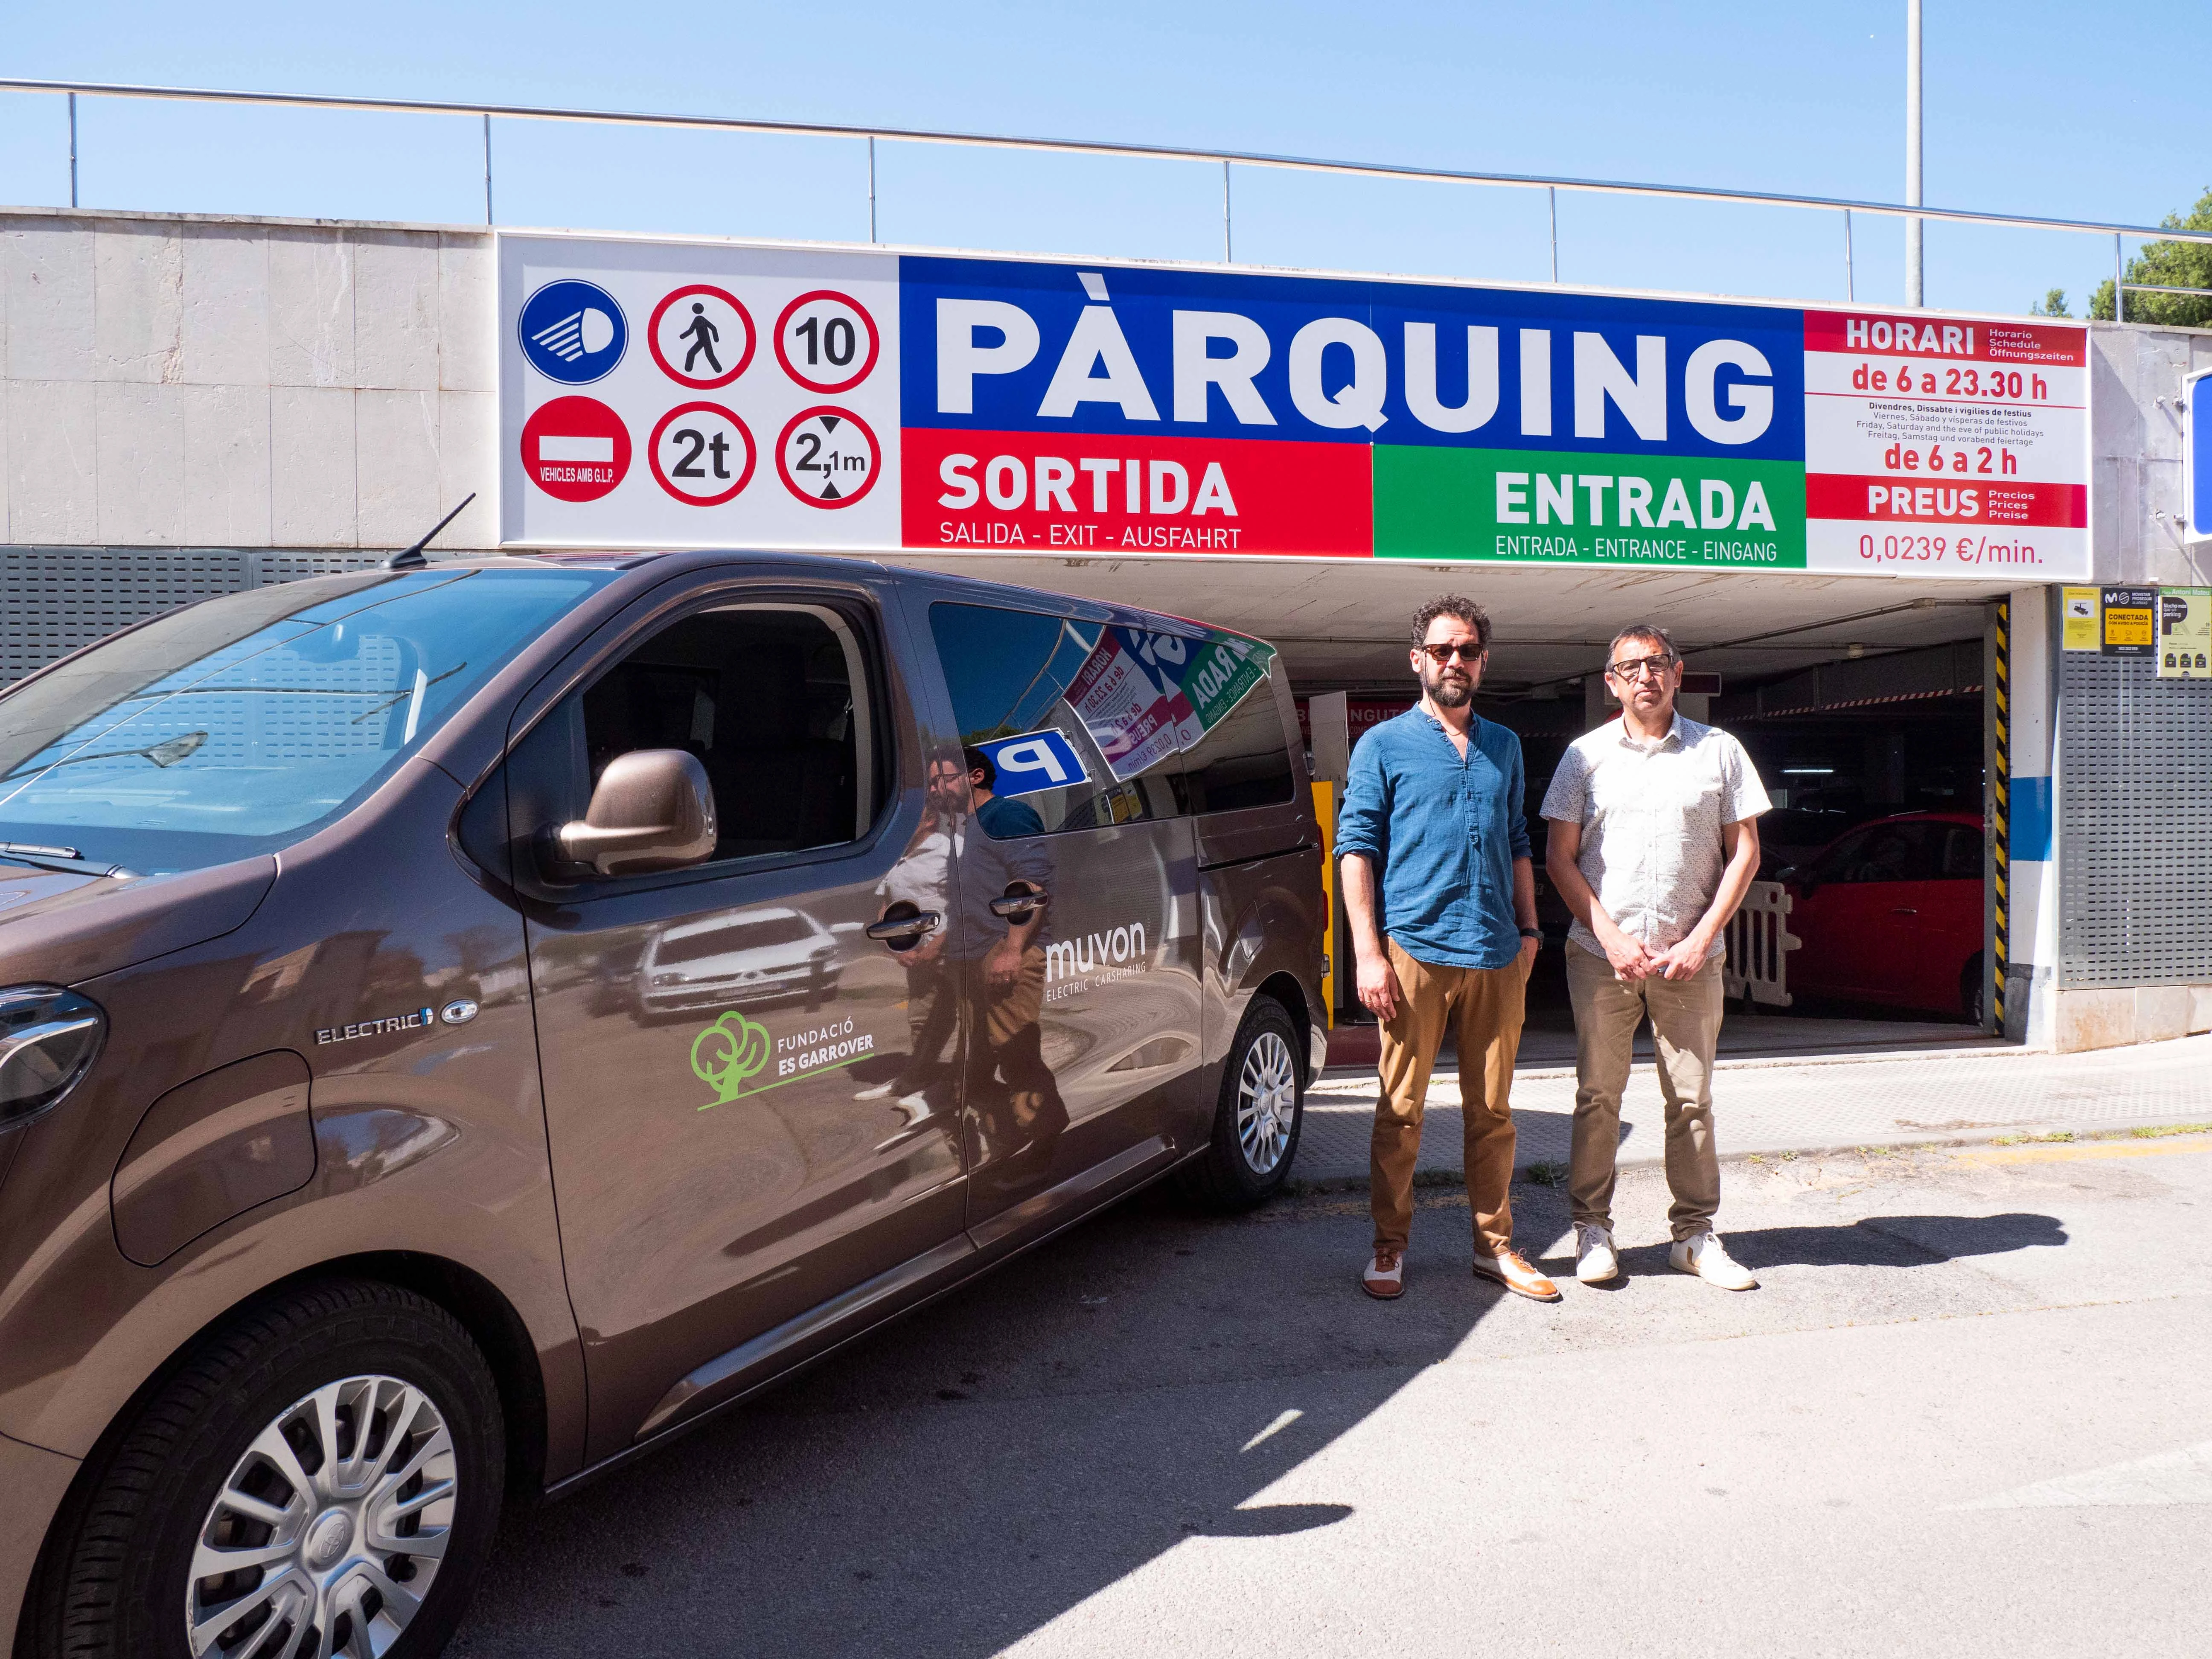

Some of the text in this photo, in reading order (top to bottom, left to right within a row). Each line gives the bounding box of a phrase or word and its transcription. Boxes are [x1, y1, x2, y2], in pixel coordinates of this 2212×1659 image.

[795, 317, 856, 366] 10
[1846, 319, 1974, 355] HORARI
[1989, 339, 2040, 349] Schedule
[1990, 329, 2032, 339] Horario
[937, 272, 1773, 444] PÀRQUING
[1989, 347, 2073, 361] Öffnungszeiten
[1853, 363, 2046, 400] de 6 a 23.30 h
[1869, 402, 1915, 412] Divendres,
[1917, 405, 1953, 413] Dissabte
[1874, 412, 1907, 421] Viernes,
[1910, 413, 1939, 422] Sábado
[1949, 416, 1982, 425] vísperas
[1857, 421, 1884, 430] Friday,
[1887, 422, 1924, 432] Saturday
[2011, 428, 2044, 438] holidays
[1868, 431, 1899, 440] Freitag,
[1902, 432, 1938, 442] Samstag
[1997, 437, 2033, 447] feiertage
[672, 428, 731, 479] 2t
[1885, 443, 2017, 474] de 6 a 2 h
[540, 467, 614, 483] VEHICLES AMB G.L.P.
[937, 453, 1238, 516] SORTIDA
[1496, 472, 1776, 531] ENTRADA
[1868, 485, 1979, 517] PREUS
[1988, 490, 2035, 499] Precios
[1988, 500, 2028, 509] Prices
[1988, 510, 2028, 519] Preise
[940, 522, 1025, 544] SALIDA
[1050, 524, 1098, 546] EXIT
[1122, 526, 1241, 548] AUSFAHRT
[1496, 535, 1578, 556] ENTRADA
[1596, 538, 1686, 559] ENTRANCE
[1704, 541, 1776, 562] EINGANG
[1860, 534, 2043, 564] 0,0239 €/min.
[1046, 922, 1146, 982] muvon
[1047, 961, 1146, 1002] ELECTRIC CARSHARING
[317, 1014, 421, 1044] ELECTRIC
[778, 1016, 853, 1053] FUNDACIÓ
[779, 1034, 874, 1076] ES GARROVER
